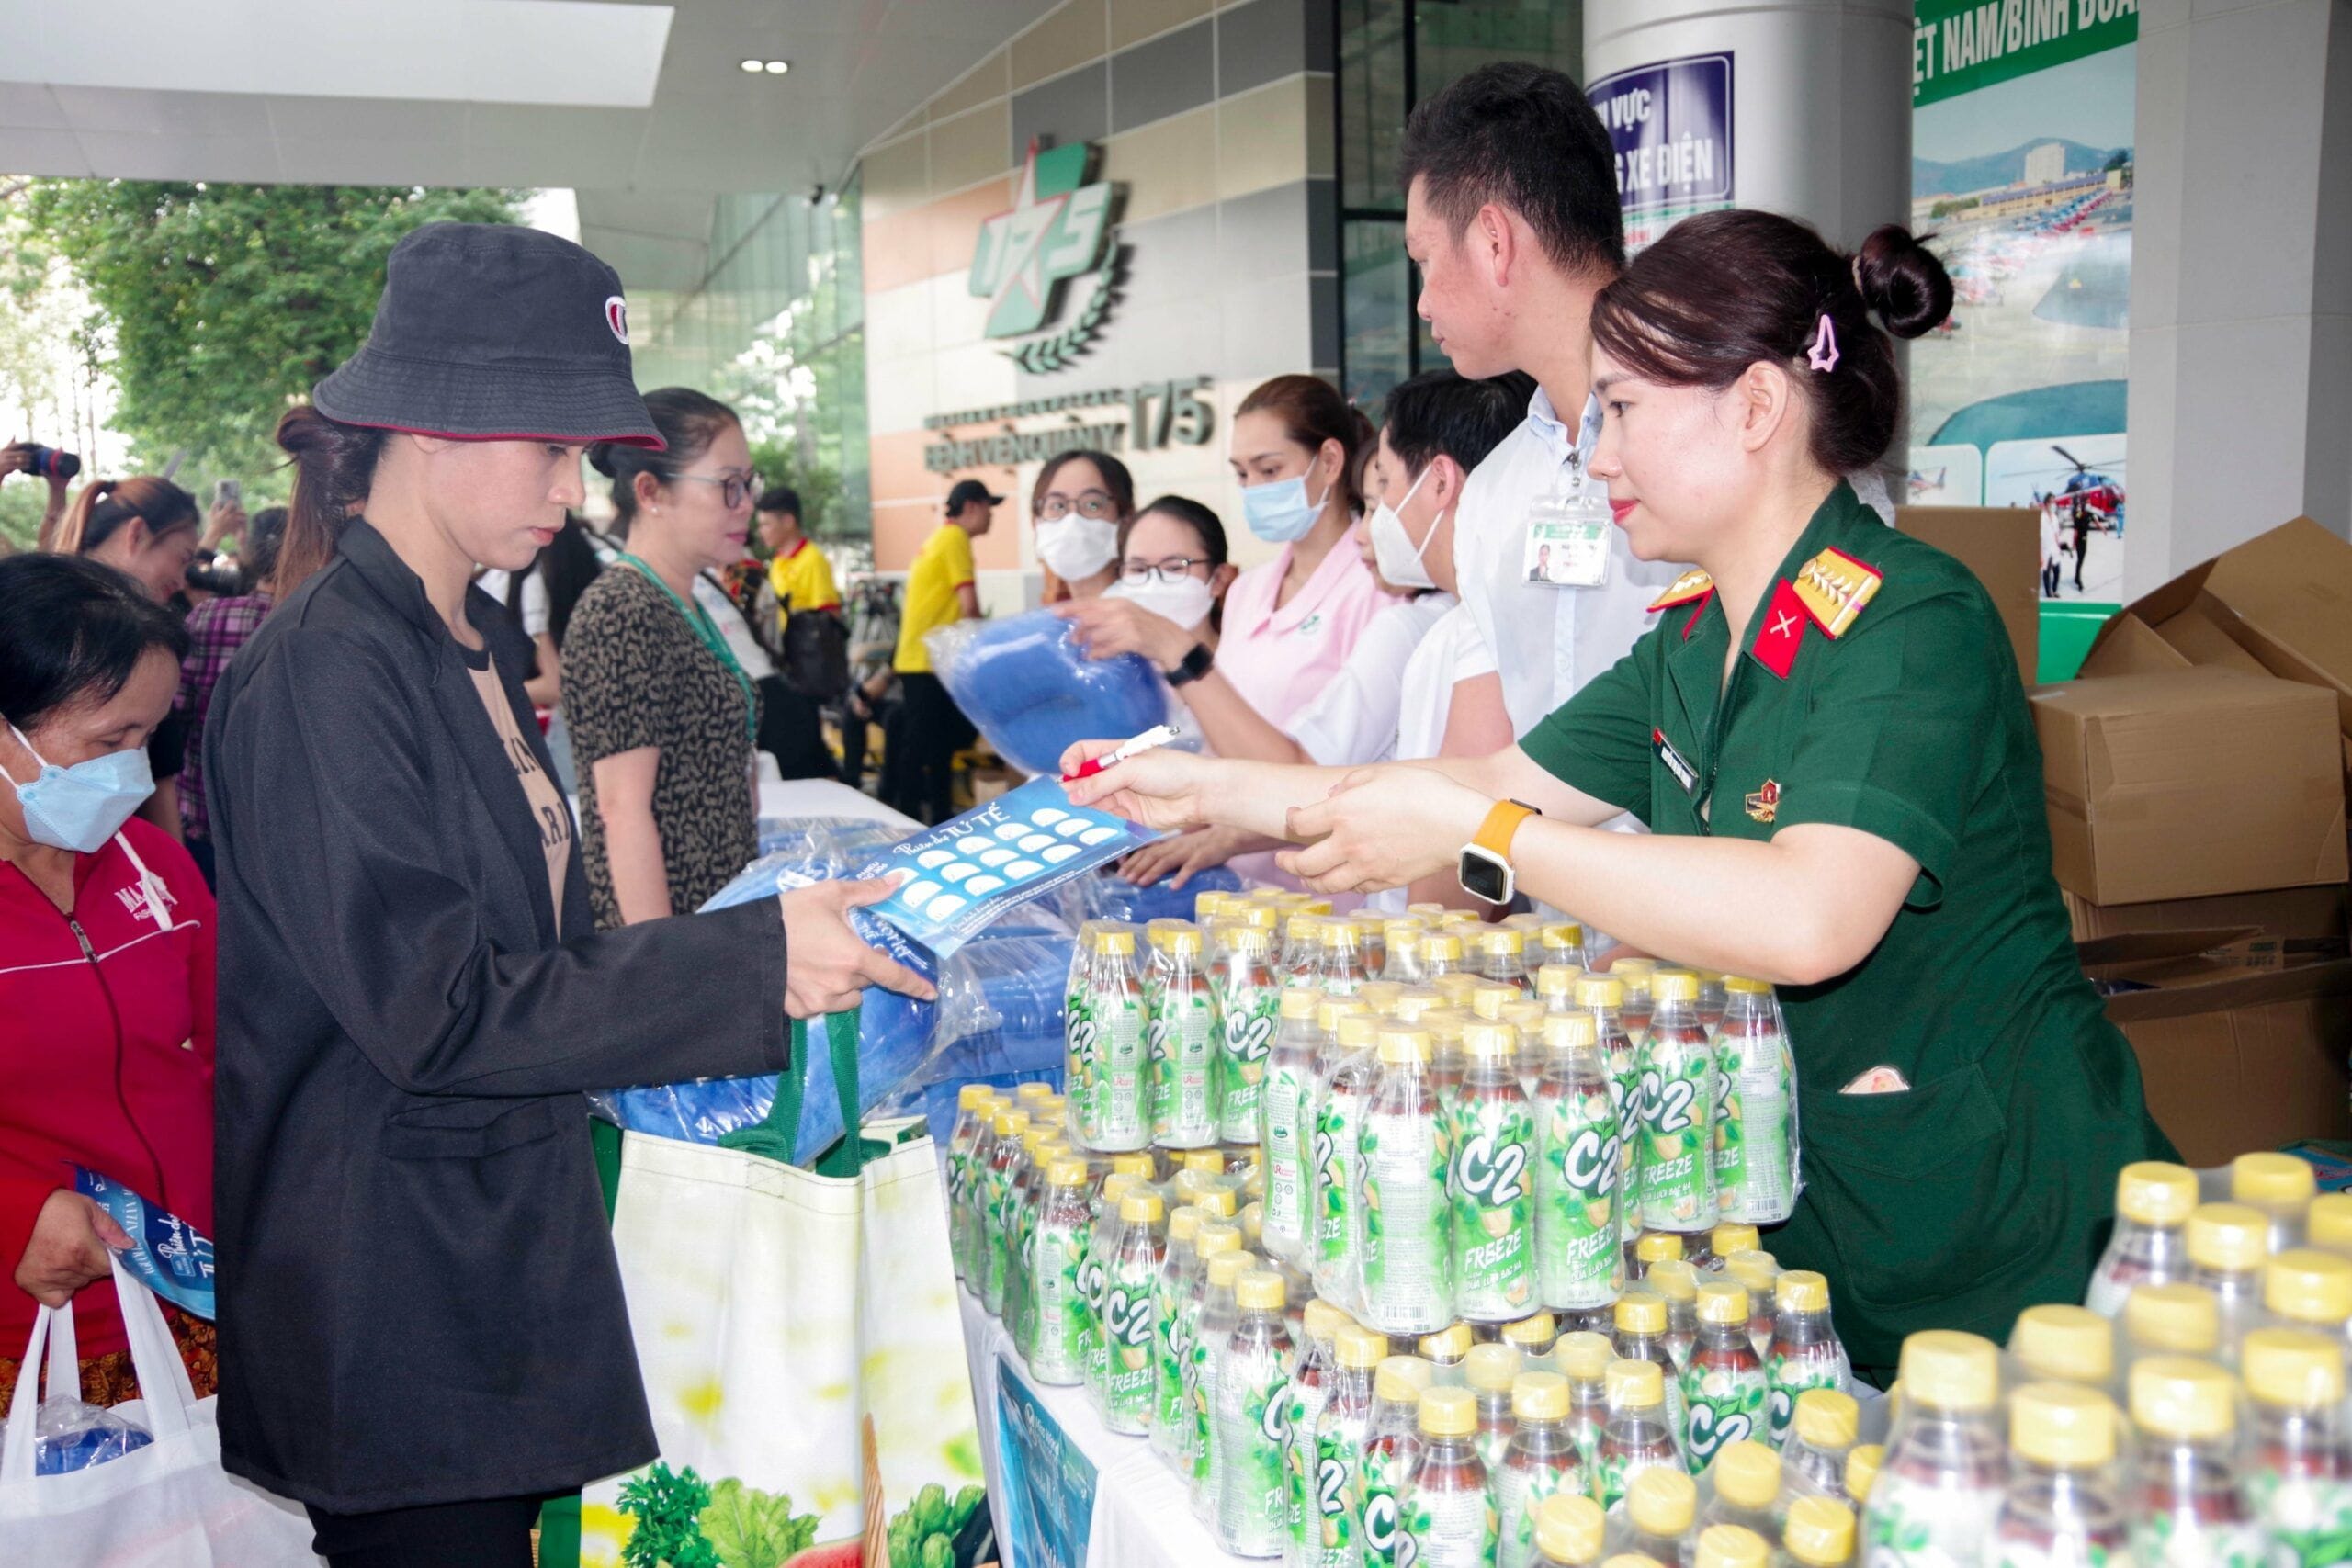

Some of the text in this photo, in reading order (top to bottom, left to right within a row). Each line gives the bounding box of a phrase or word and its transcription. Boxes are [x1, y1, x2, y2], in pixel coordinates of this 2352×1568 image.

[1914, 17, 1937, 96] ỆT
[1611, 87, 1651, 132] VỰC
[1626, 147, 1652, 193] XE
[1657, 130, 1713, 193] ĐIỆN
[1131, 376, 1215, 452] 175
[1225, 1010, 1272, 1062] C2
[1228, 1085, 1259, 1109] FREE
[1641, 1071, 1695, 1135] C2
[1458, 1135, 1525, 1206] C2
[1565, 1131, 1622, 1195] C2
[1643, 1154, 1693, 1187] FREEZE
[1464, 1227, 1521, 1273] FREEZE
[1107, 1289, 1151, 1346] C2
[1318, 1458, 1347, 1516] 2
